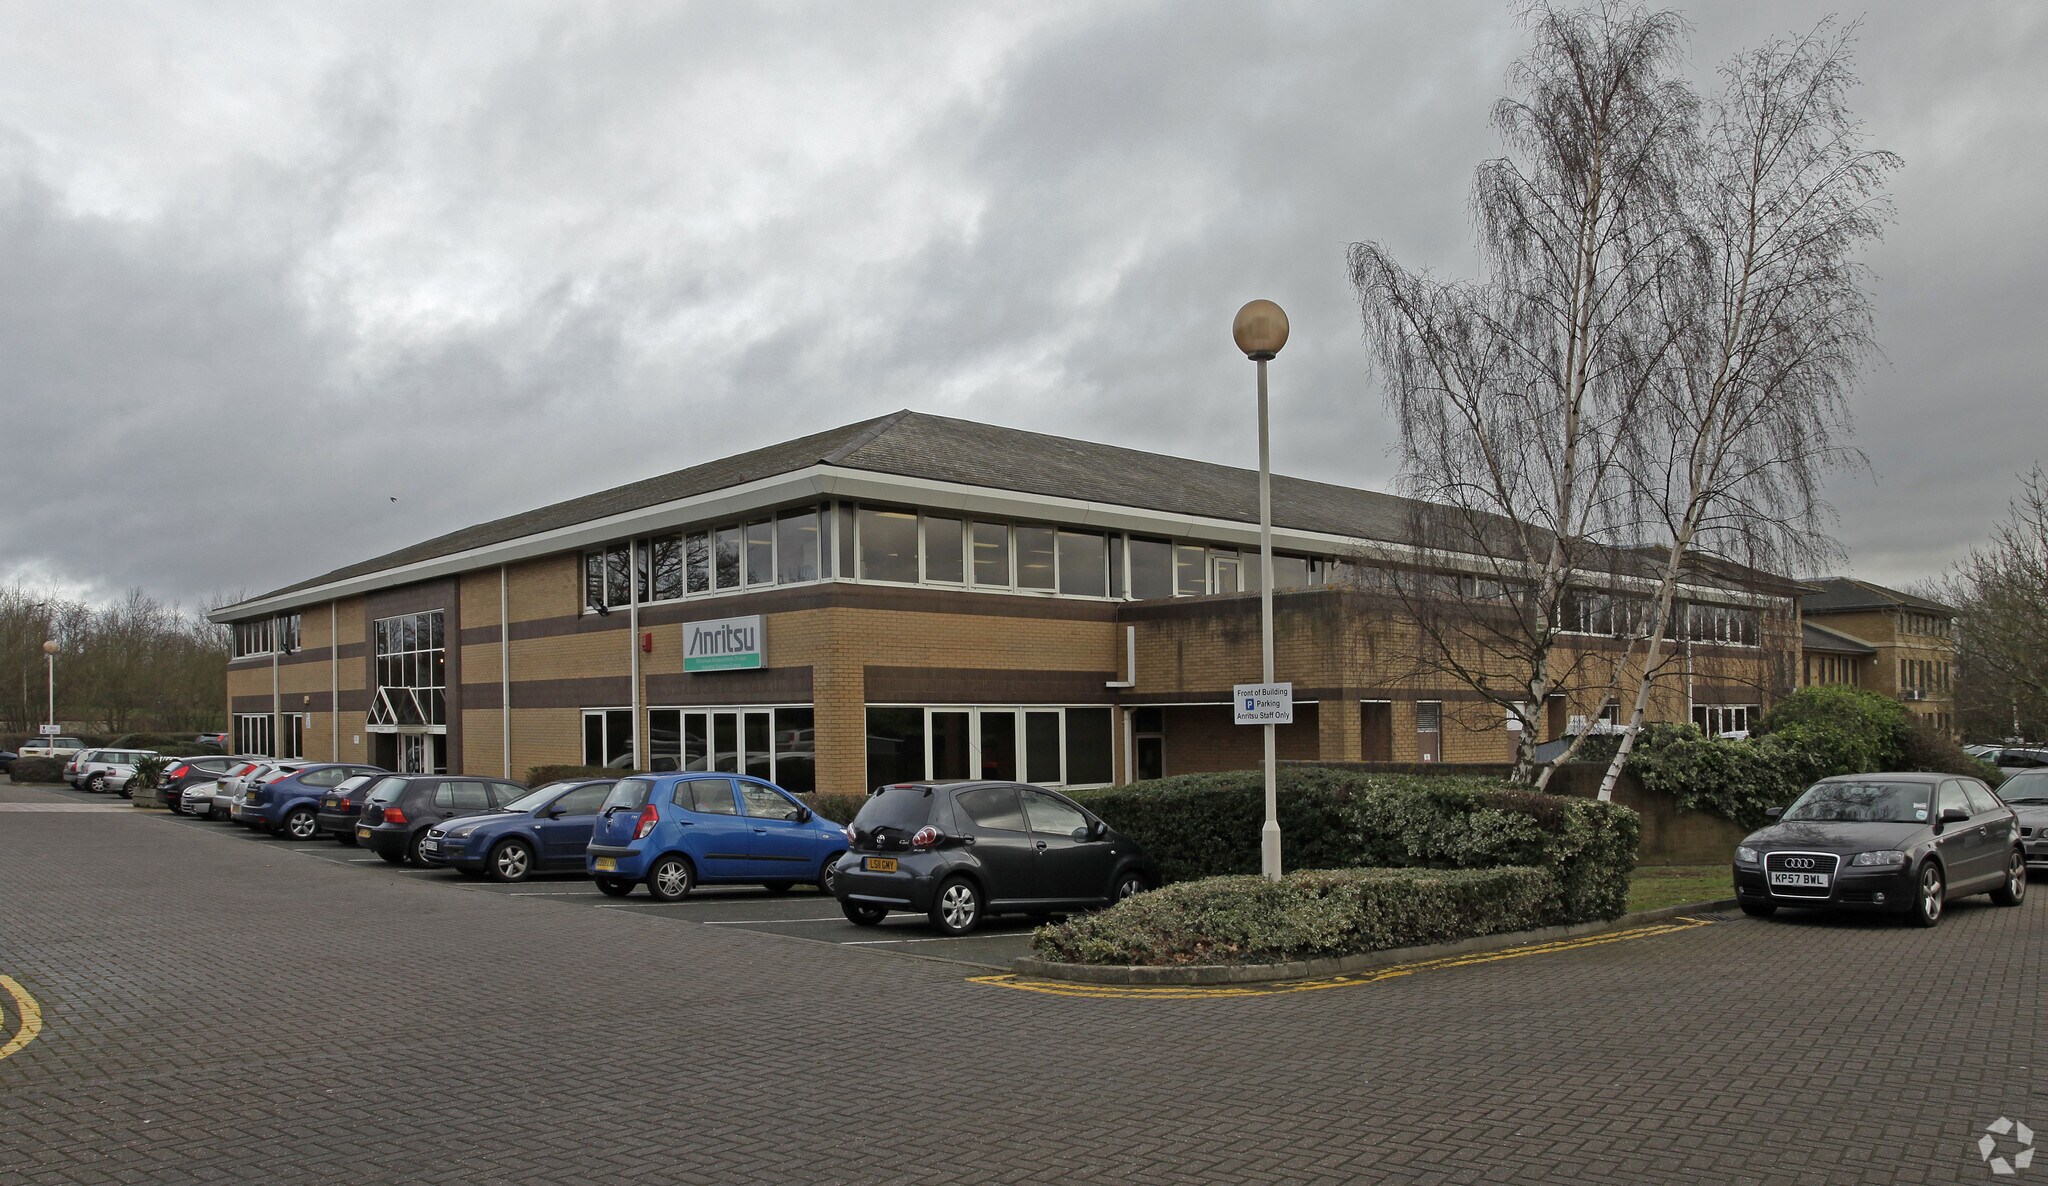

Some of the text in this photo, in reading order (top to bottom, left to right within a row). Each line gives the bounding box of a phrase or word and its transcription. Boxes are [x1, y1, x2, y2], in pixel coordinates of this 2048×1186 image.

[689, 624, 755, 656] Anritsu
[1237, 688, 1288, 697] Front of Building
[1256, 700, 1281, 708] Parking
[1236, 711, 1290, 720] Anritsu Staff Only
[881, 859, 895, 870] GMY
[1775, 873, 1824, 885] KP57 BWL
